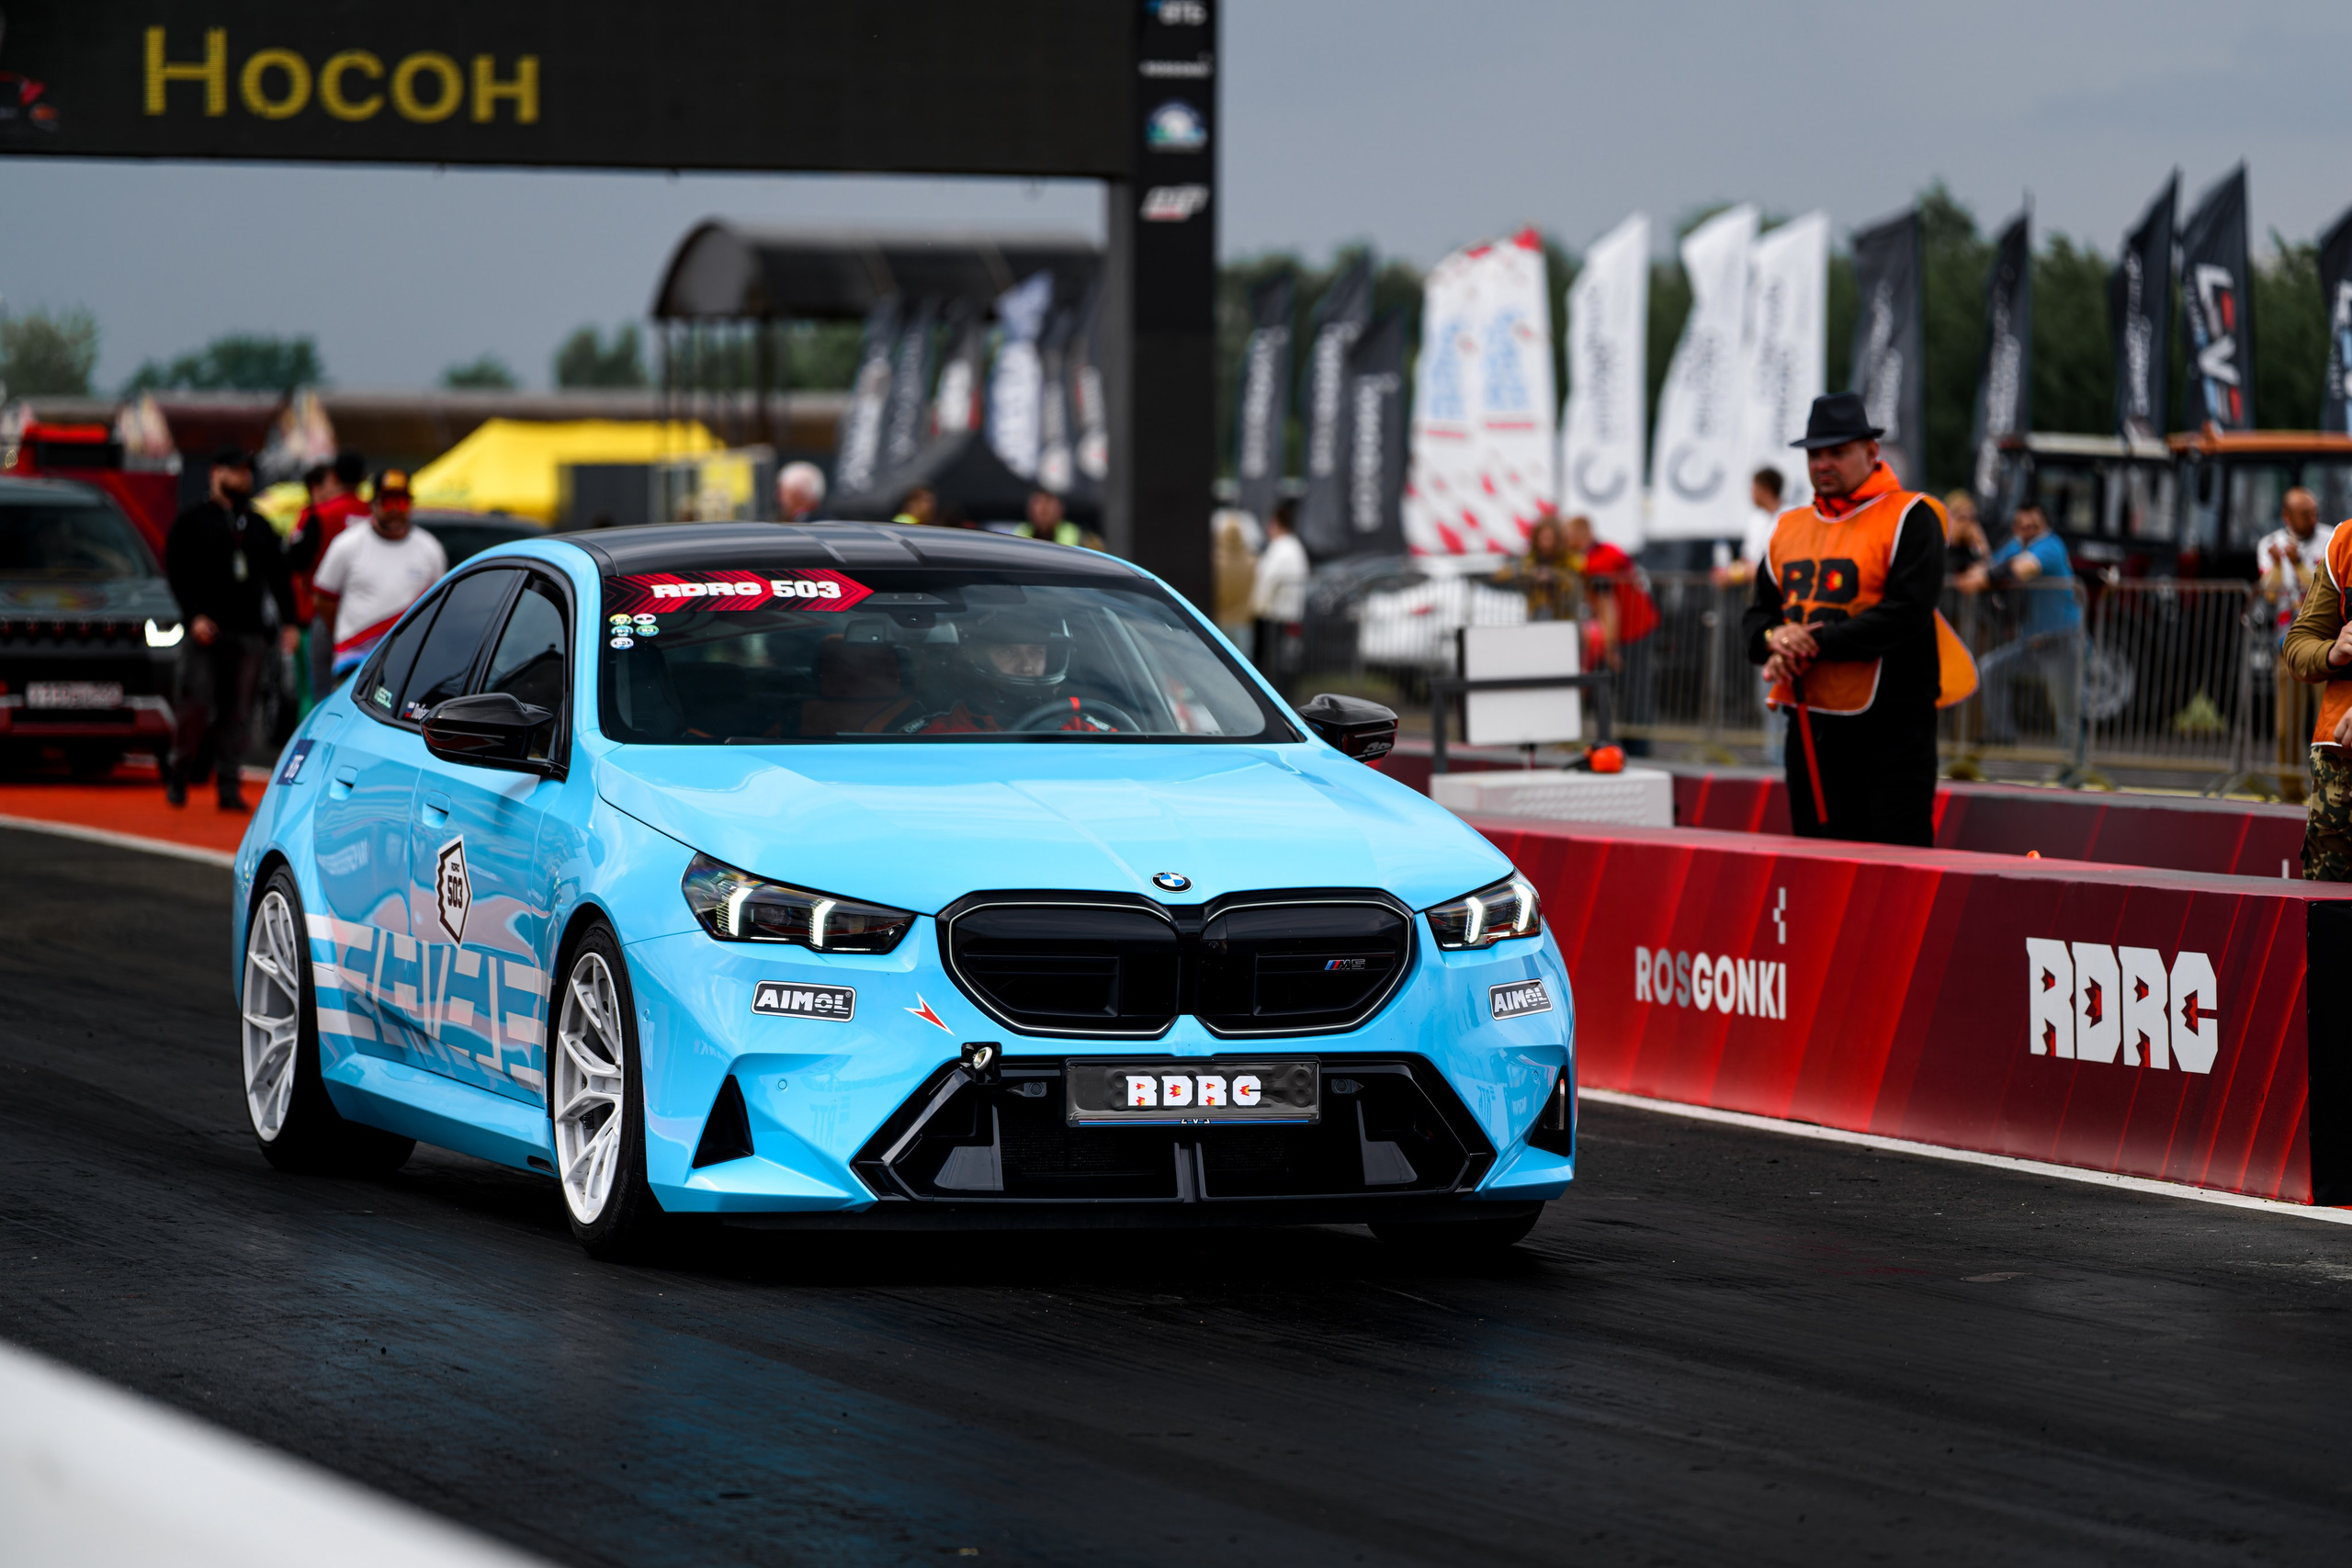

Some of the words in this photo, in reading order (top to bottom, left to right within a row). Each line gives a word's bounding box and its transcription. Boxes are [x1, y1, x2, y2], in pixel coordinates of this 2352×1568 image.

[650, 581, 762, 598] RDRC
[770, 580, 842, 598] 503
[447, 874, 463, 908] 503
[1634, 946, 1787, 1021] ROSGONKI
[2026, 937, 2219, 1074] RDRC
[1125, 1075, 1261, 1106] RDRC
